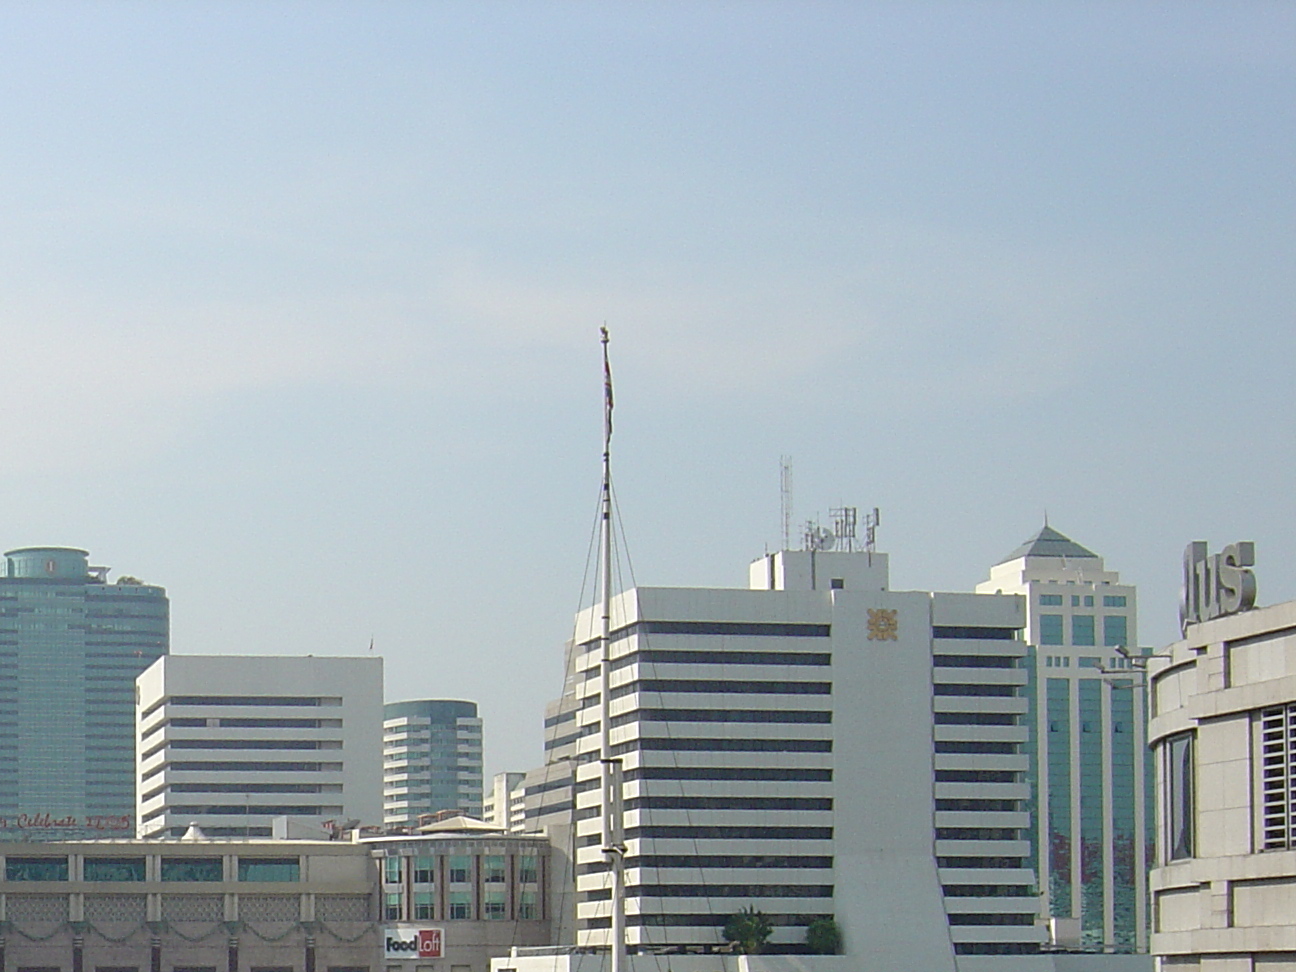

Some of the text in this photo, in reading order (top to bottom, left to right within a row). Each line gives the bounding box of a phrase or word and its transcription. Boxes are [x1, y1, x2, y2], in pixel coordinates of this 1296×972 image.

[17, 812, 77, 829] Celebrate
[386, 933, 440, 952] Food Loft
